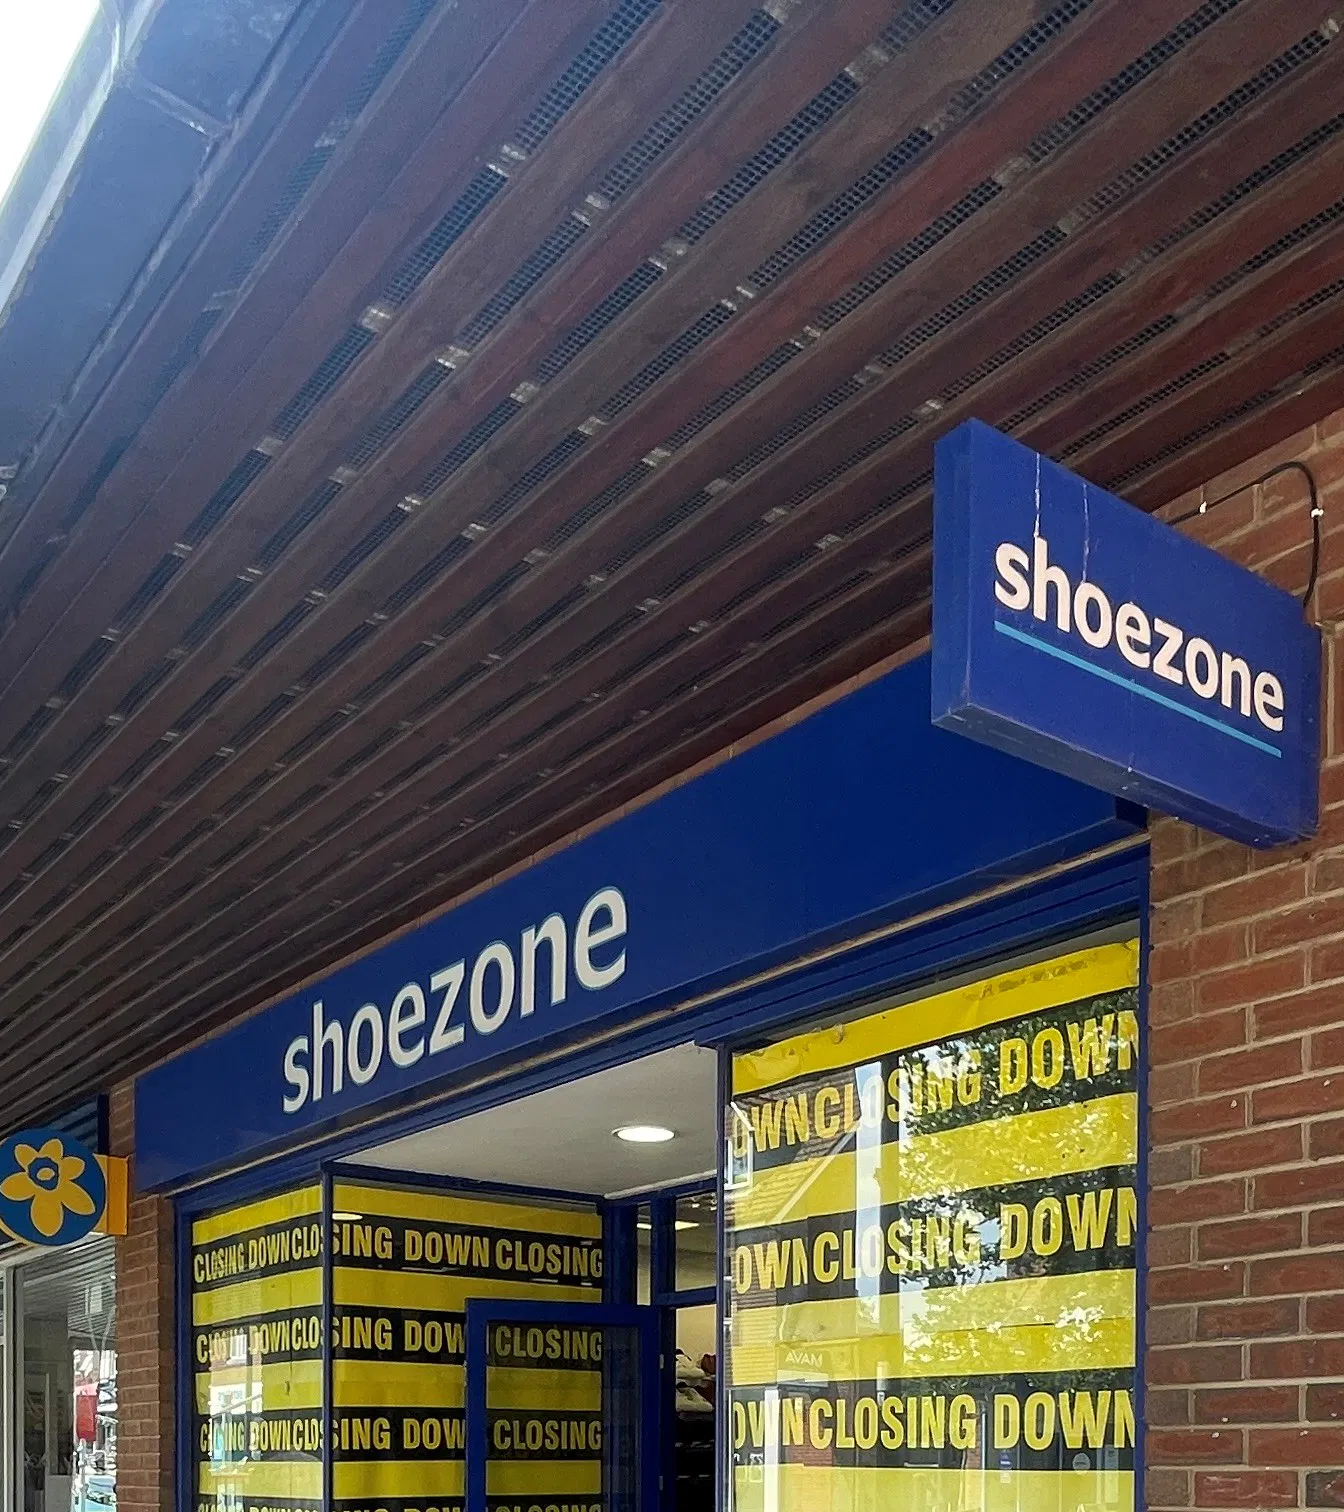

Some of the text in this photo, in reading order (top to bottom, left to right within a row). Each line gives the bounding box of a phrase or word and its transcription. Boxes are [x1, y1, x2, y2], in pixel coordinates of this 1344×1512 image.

[993, 535, 1285, 732] shoezone
[282, 885, 628, 1115] shoezone
[814, 1050, 982, 1139] CLOSING
[194, 1223, 324, 1283] CLOSING DOWN CLO
[404, 1229, 490, 1268] DOWN
[495, 1238, 603, 1278] CLOSING
[813, 1209, 982, 1283] CLOSING
[999, 1186, 1138, 1260] DOWN
[291, 1315, 324, 1351] CLO
[404, 1319, 466, 1354] DOW
[495, 1325, 602, 1362] CLOSING
[403, 1418, 466, 1450] DOW
[493, 1419, 602, 1451] CLOSING
[809, 1394, 977, 1451] CLOSING
[993, 1390, 1135, 1451] DOWN
